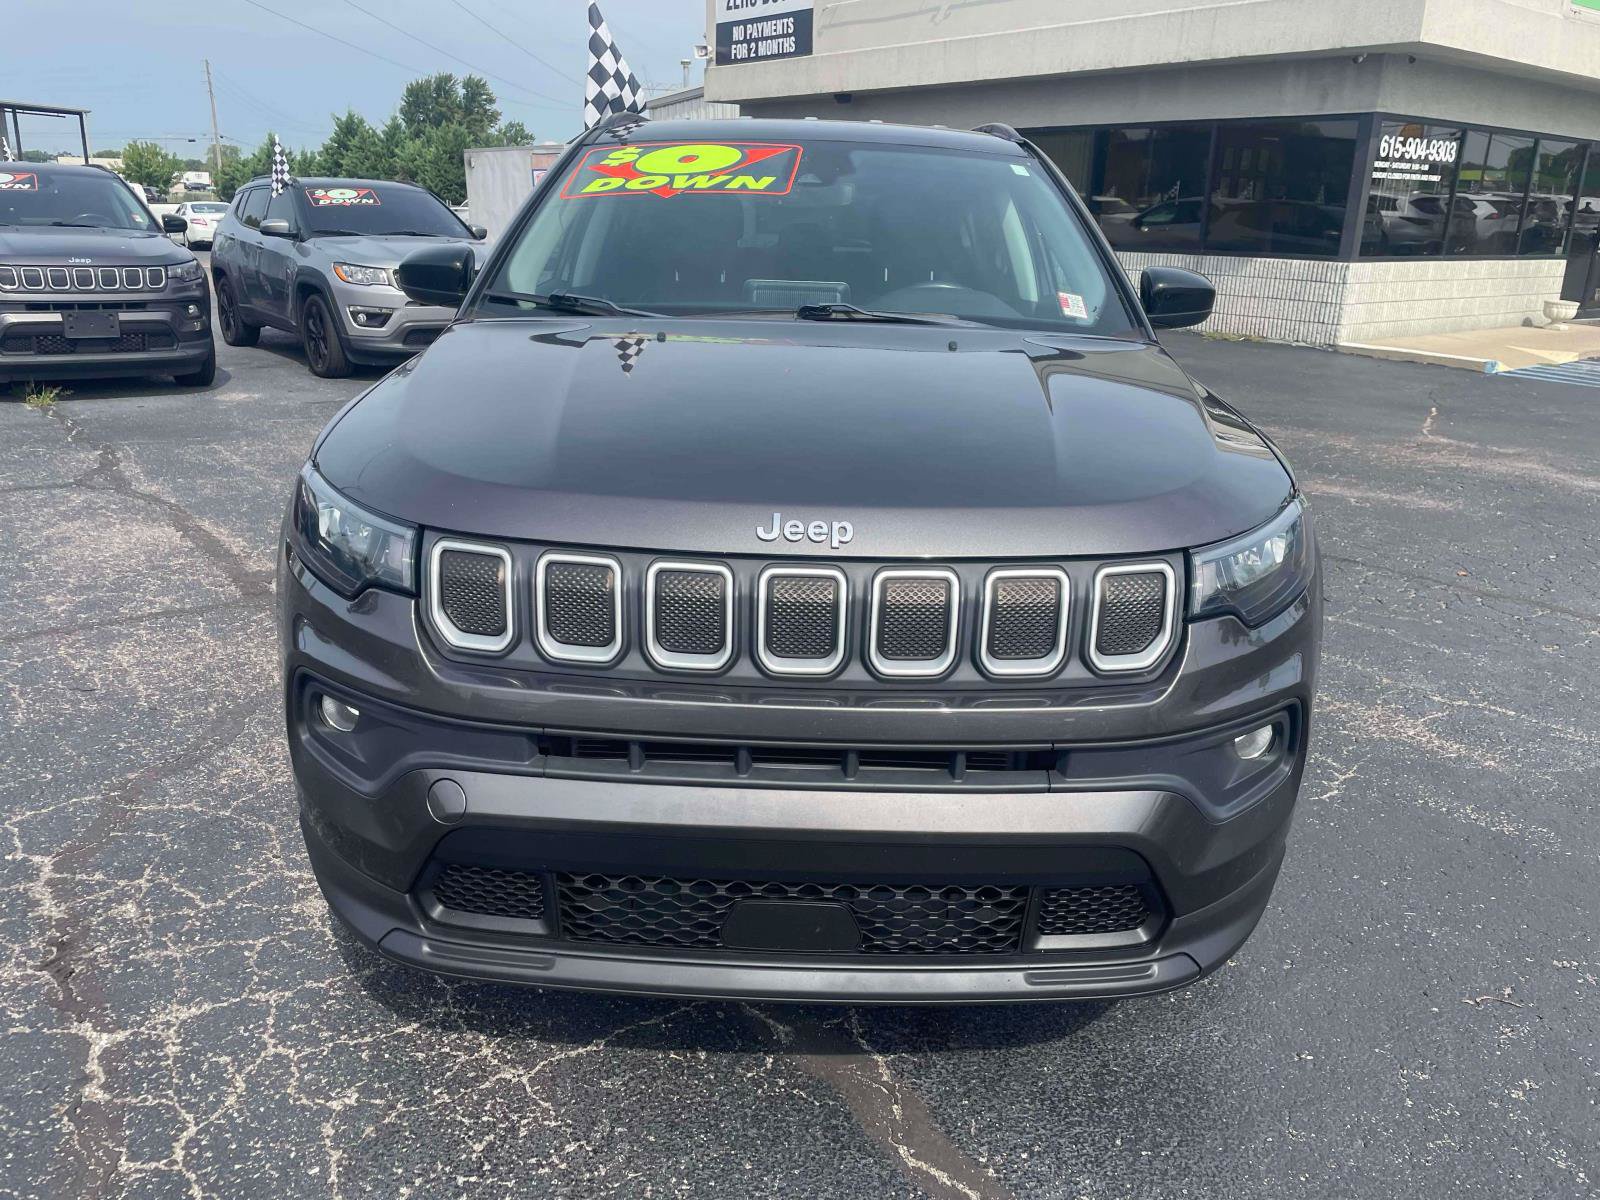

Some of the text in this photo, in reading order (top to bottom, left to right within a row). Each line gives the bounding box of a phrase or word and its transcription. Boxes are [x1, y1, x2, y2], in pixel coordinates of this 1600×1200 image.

[732, 17, 794, 41] NO PAYMENTS
[731, 36, 796, 60] FOR 2 MONTHS
[1379, 134, 1457, 163] 615-904-9303
[581, 175, 777, 193] DOWN
[68, 256, 92, 264] Jeep
[756, 512, 854, 549] Jeep
